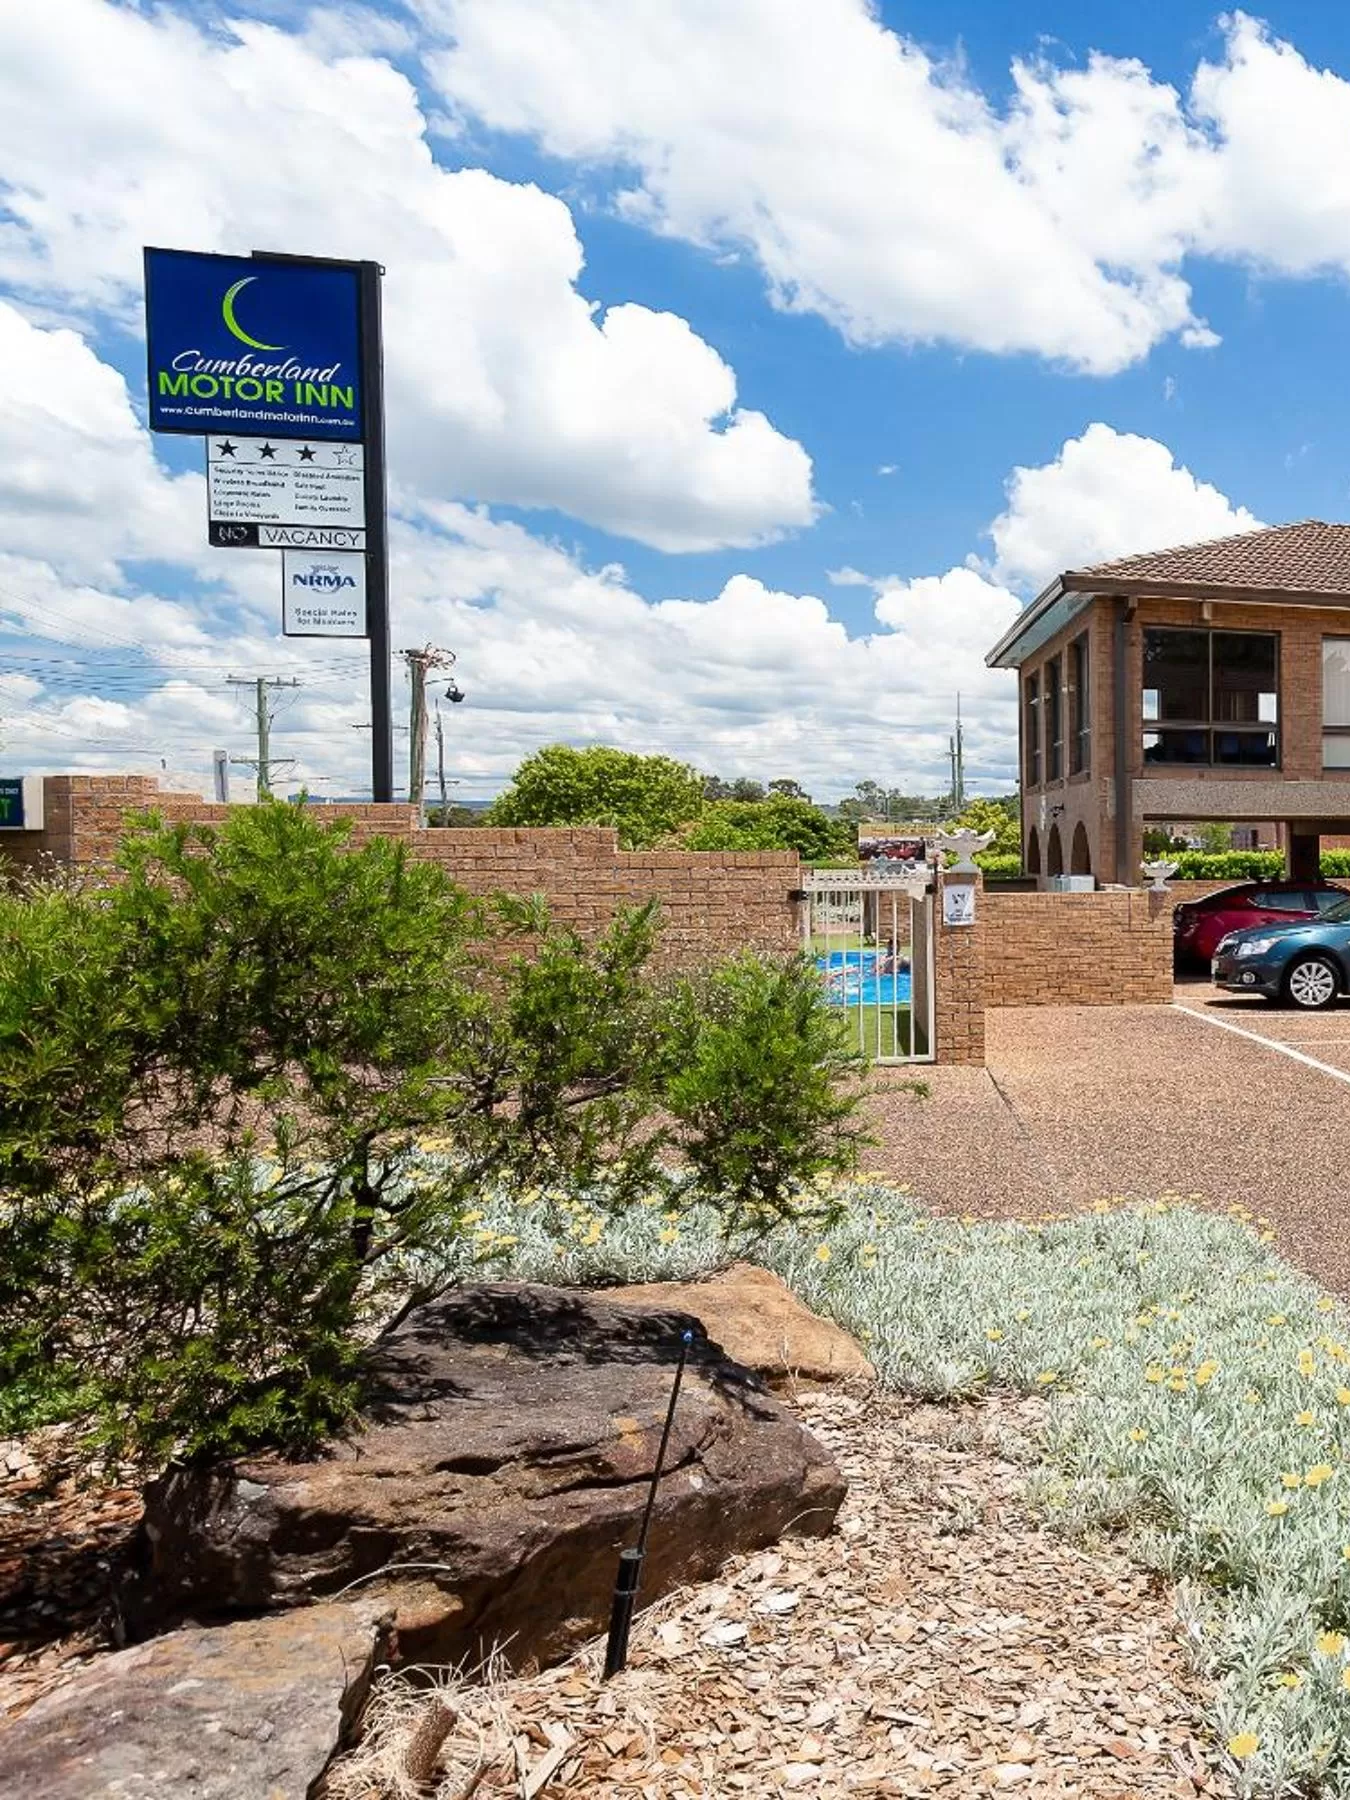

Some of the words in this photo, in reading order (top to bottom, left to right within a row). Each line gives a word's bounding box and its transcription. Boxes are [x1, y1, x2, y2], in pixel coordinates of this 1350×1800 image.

[171, 349, 342, 383] Cumberland
[158, 371, 284, 404] MOTOR
[295, 381, 354, 409] INN
[218, 526, 248, 541] NO
[264, 528, 360, 547] VACANCY
[293, 573, 357, 588] NRMA
